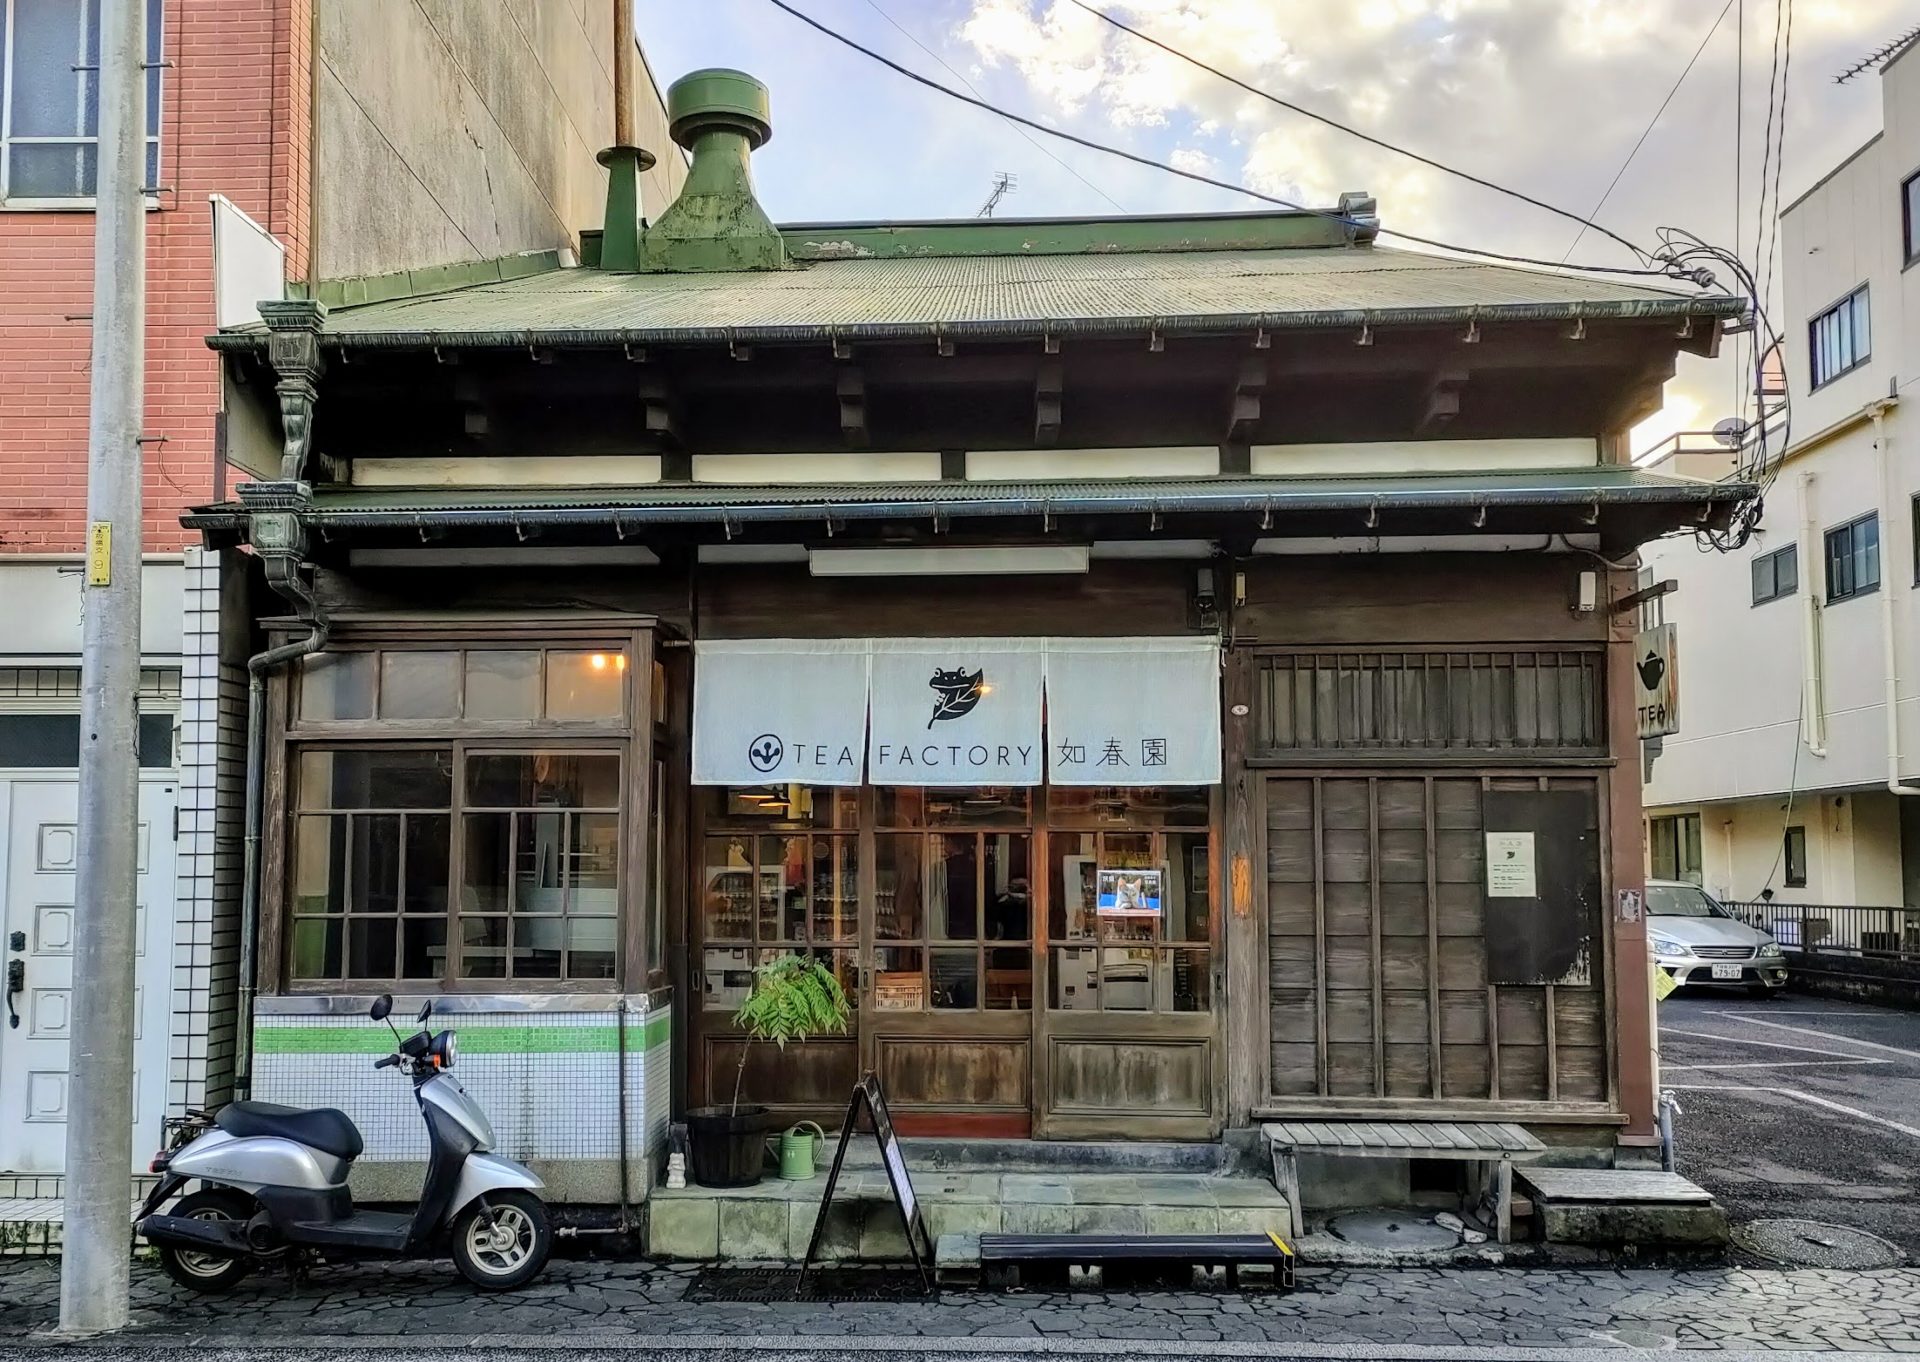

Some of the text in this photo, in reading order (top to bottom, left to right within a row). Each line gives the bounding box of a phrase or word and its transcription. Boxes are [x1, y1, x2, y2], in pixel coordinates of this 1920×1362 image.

[1638, 703, 1666, 723] TEA
[792, 736, 1168, 767] TEA FACTORY 如春園
